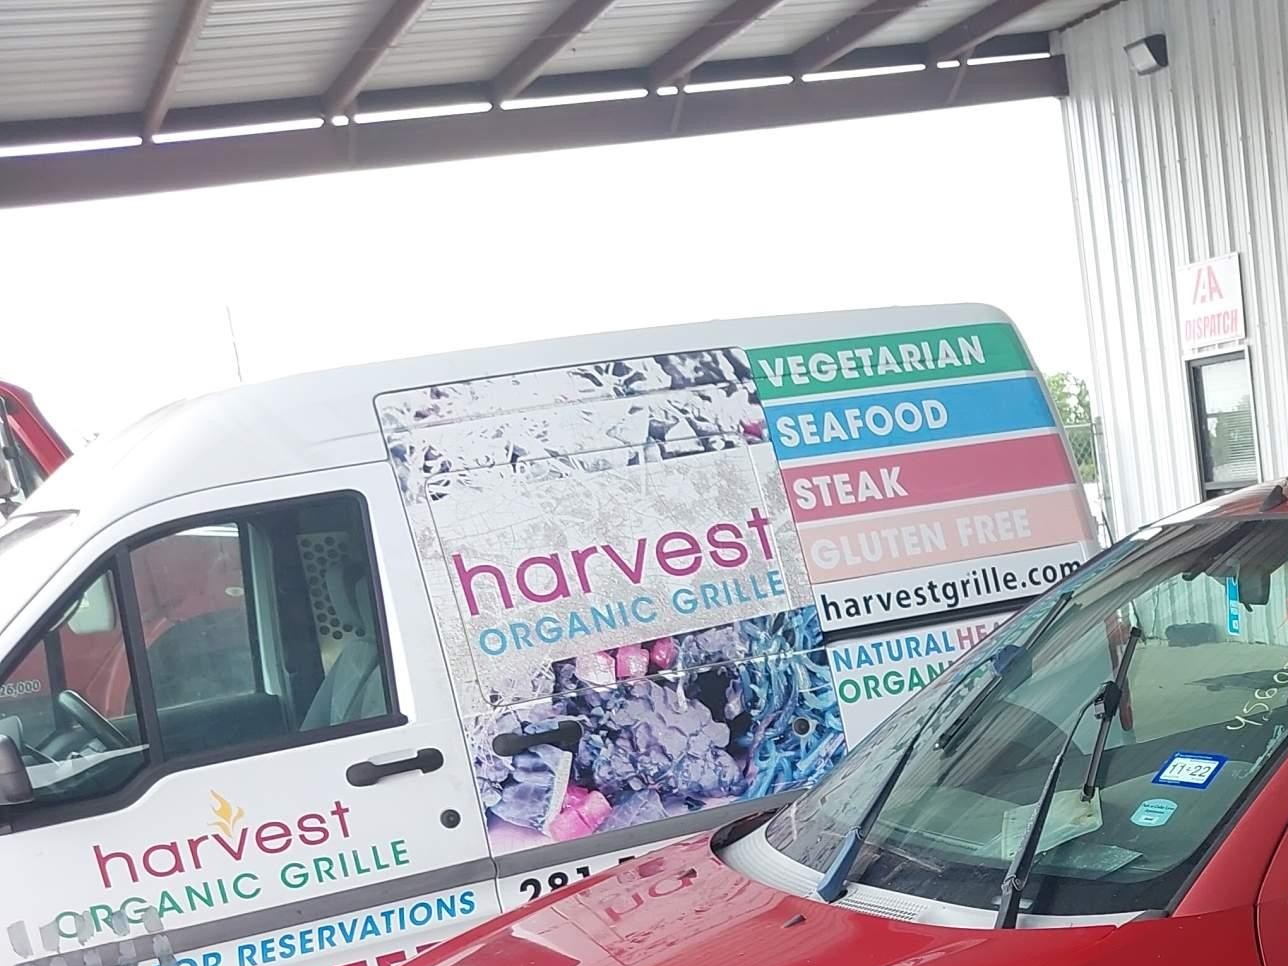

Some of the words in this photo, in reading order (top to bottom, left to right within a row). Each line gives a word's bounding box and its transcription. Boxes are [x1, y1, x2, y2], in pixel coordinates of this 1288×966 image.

[1185, 308, 1238, 340] DISPATCH
[758, 335, 986, 388] VEGETARIAN
[776, 399, 948, 448] SEAFOOD
[792, 466, 909, 510] STEAK
[452, 507, 774, 617] harvest
[811, 520, 946, 570] GLUTEN
[955, 509, 1032, 547] FREE
[479, 597, 658, 656] ORGANIC
[671, 570, 786, 615] GRILLE
[821, 560, 1081, 621] harvestgrille.com
[832, 631, 956, 672] NATURAL
[956, 622, 1000, 650] HE
[838, 660, 953, 703] ORGAN
[93, 800, 350, 889] harvest
[55, 872, 262, 939] ORGANIC
[280, 839, 410, 889] GRILLE
